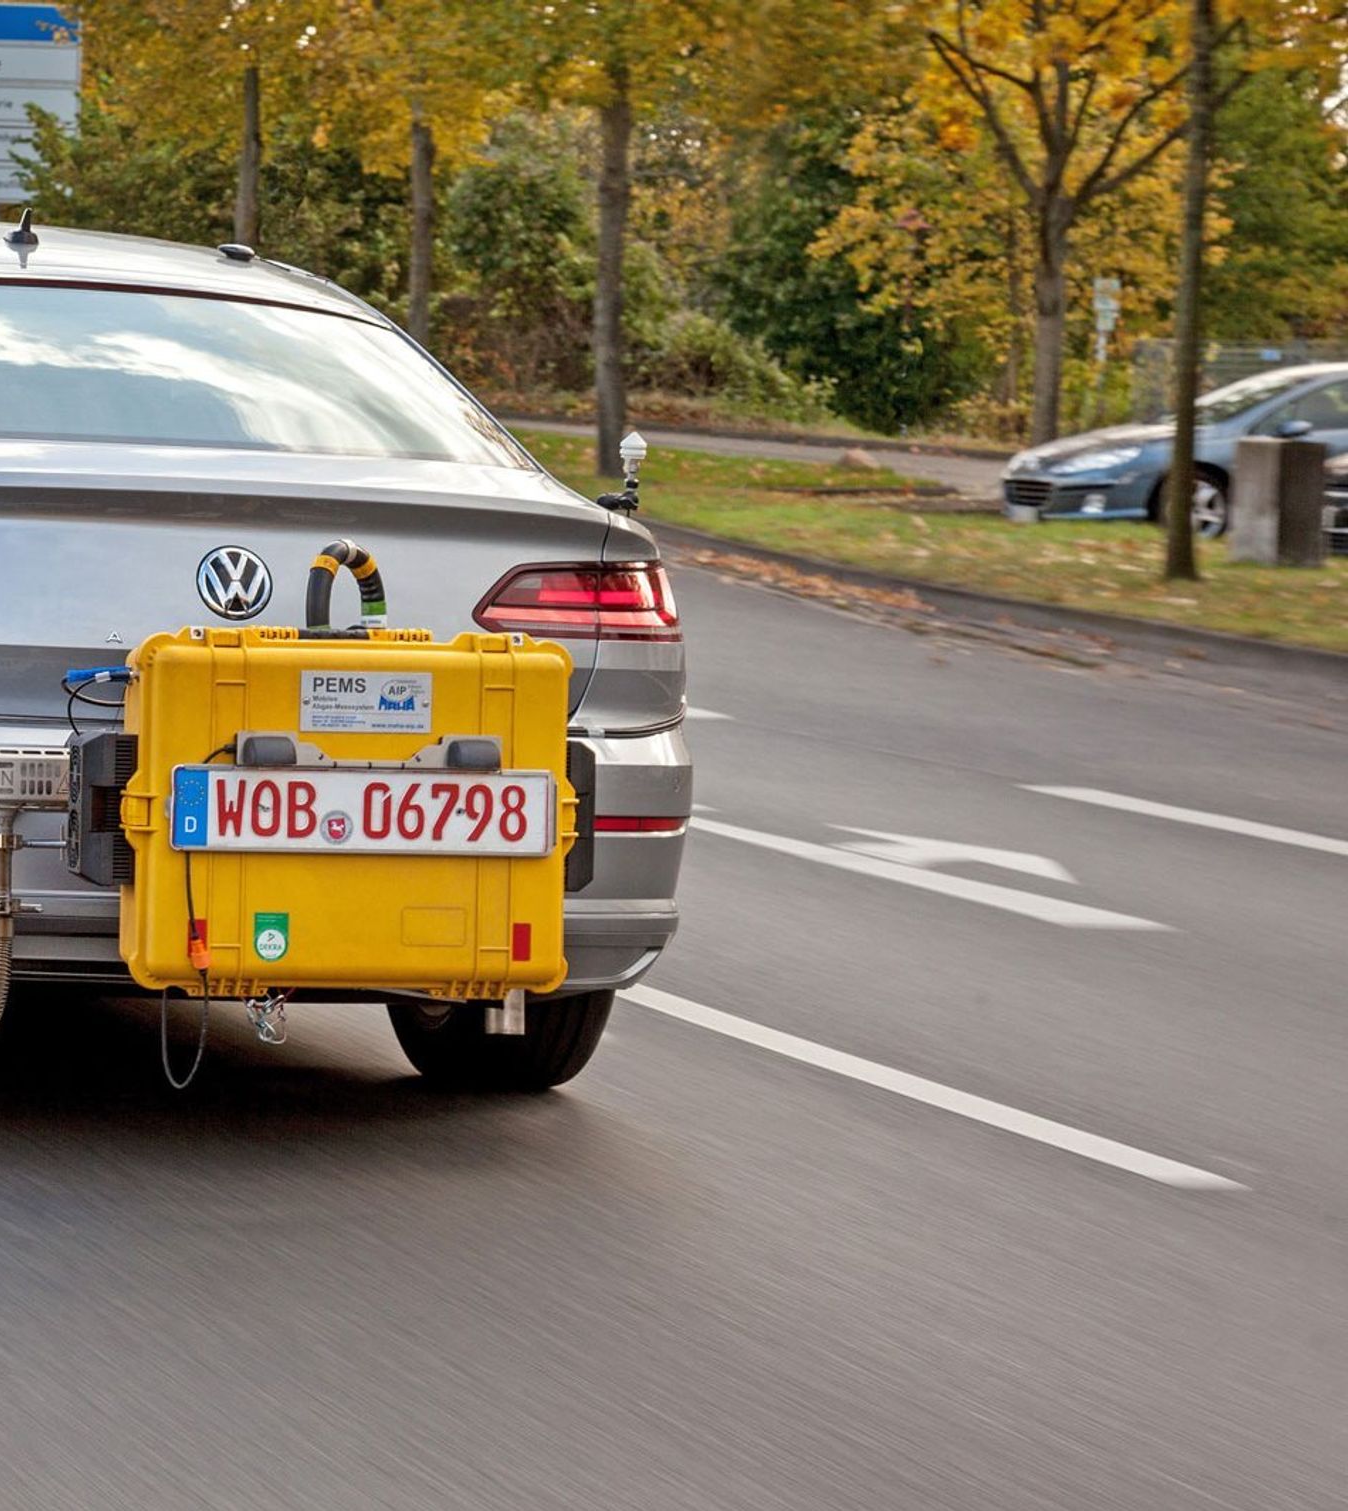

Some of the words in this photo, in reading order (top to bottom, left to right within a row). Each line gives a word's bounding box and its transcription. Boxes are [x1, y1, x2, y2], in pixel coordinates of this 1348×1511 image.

[312, 677, 366, 693] PEMS
[388, 685, 407, 696] AIP
[216, 779, 317, 839] WOB
[362, 782, 527, 843] 06798
[184, 816, 197, 833] D
